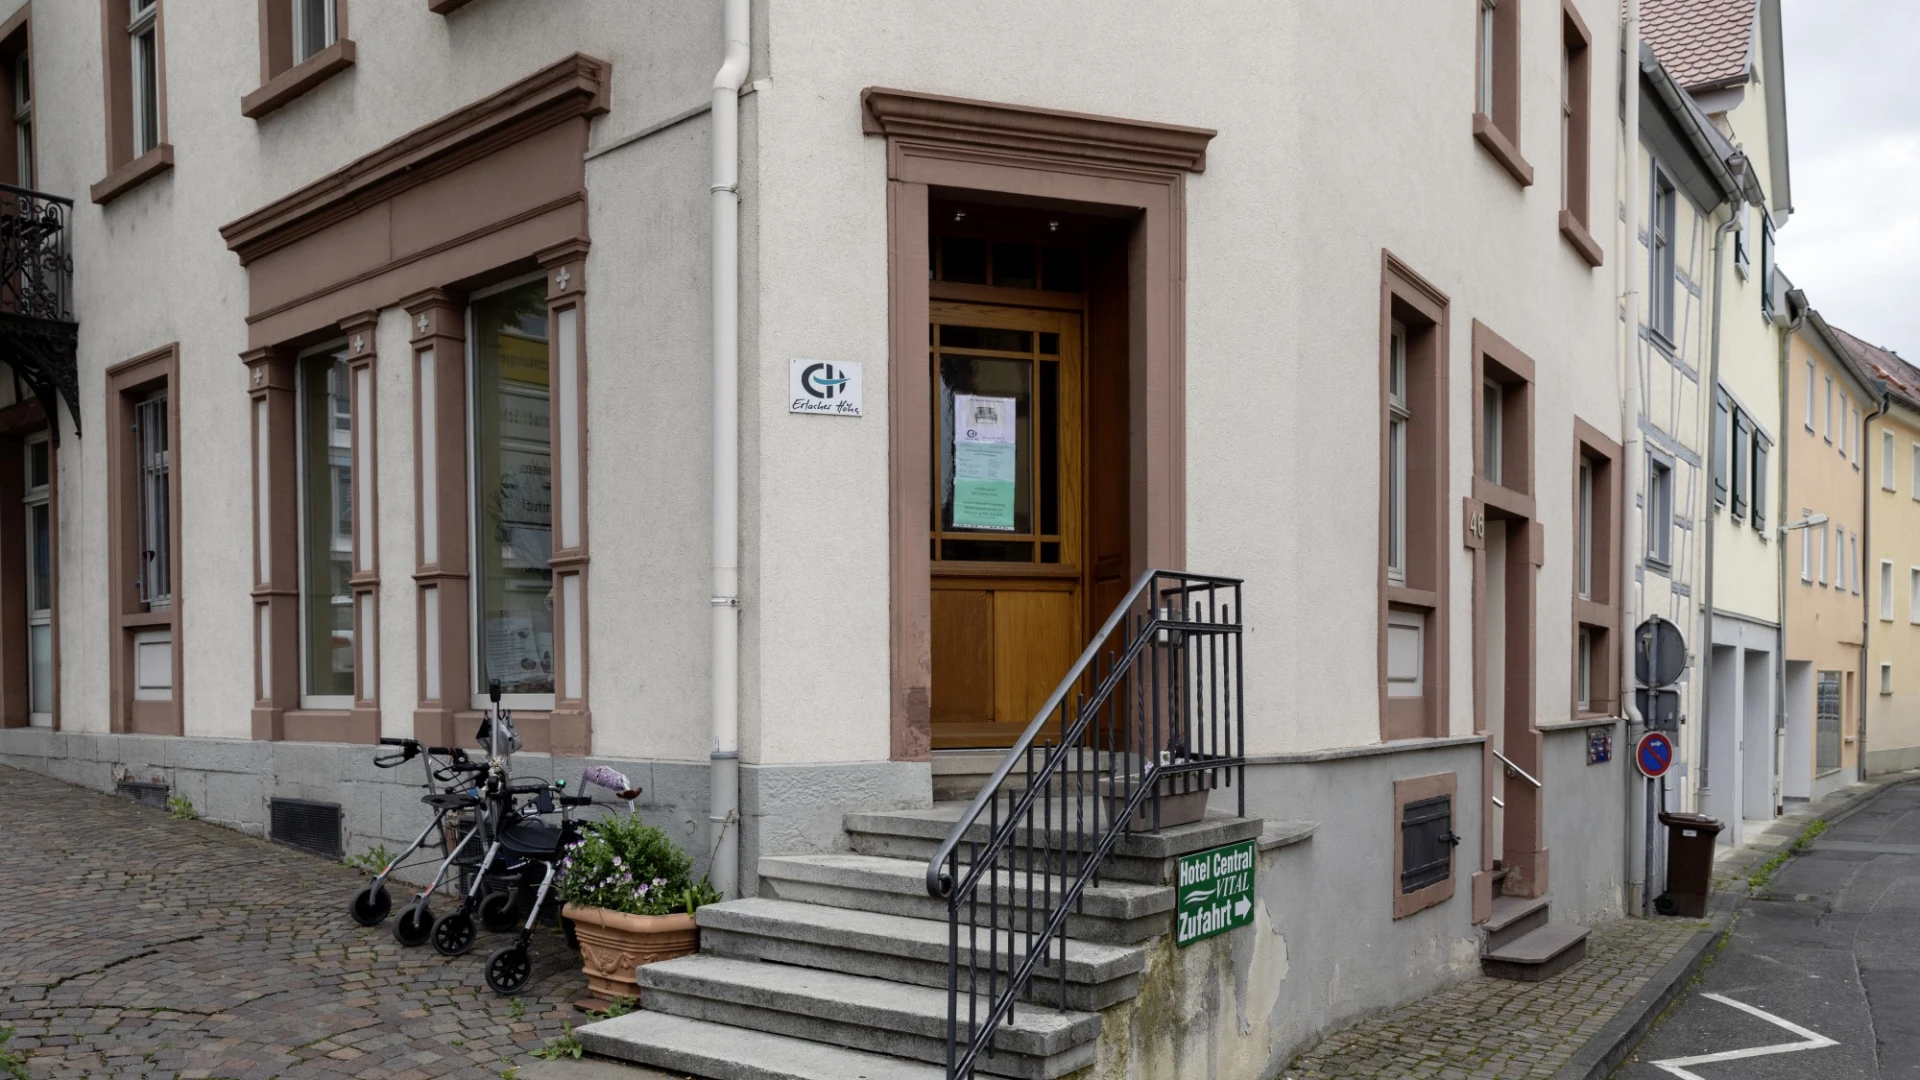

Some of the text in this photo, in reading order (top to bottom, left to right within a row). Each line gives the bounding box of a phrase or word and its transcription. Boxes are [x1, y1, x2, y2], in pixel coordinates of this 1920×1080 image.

[792, 398, 860, 414] Erlacher Höhe
[1469, 510, 1485, 538] 46
[1180, 845, 1252, 887] Hotel Central
[1216, 872, 1249, 899] VITAL
[1179, 899, 1232, 942] Zufahrt
